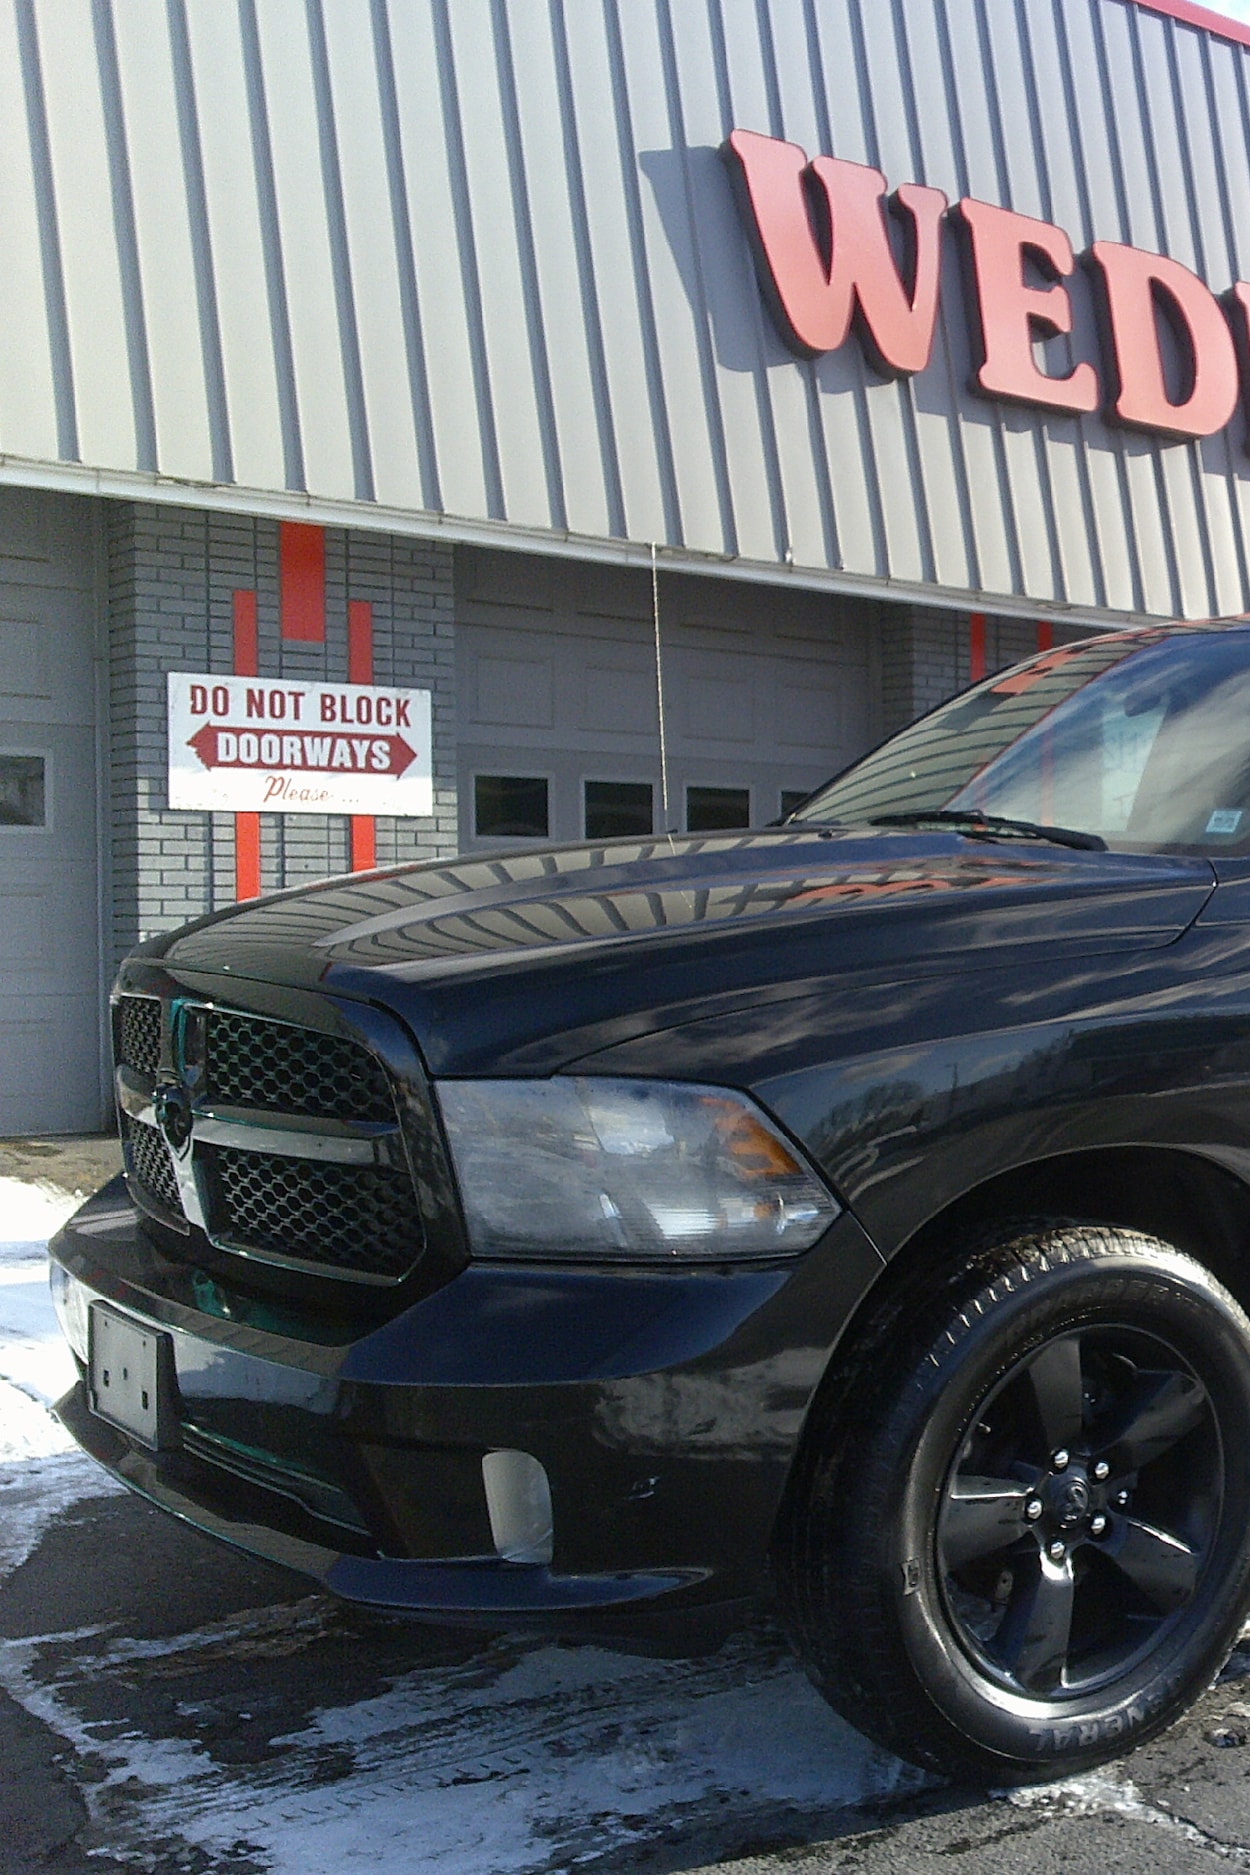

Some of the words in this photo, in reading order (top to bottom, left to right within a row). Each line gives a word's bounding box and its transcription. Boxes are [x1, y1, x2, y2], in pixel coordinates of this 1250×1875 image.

[190, 684, 230, 716] DO
[246, 688, 305, 721] NOT
[320, 693, 411, 727] BLOCK
[216, 732, 392, 771] DOORWAYS
[263, 775, 331, 803] Please
